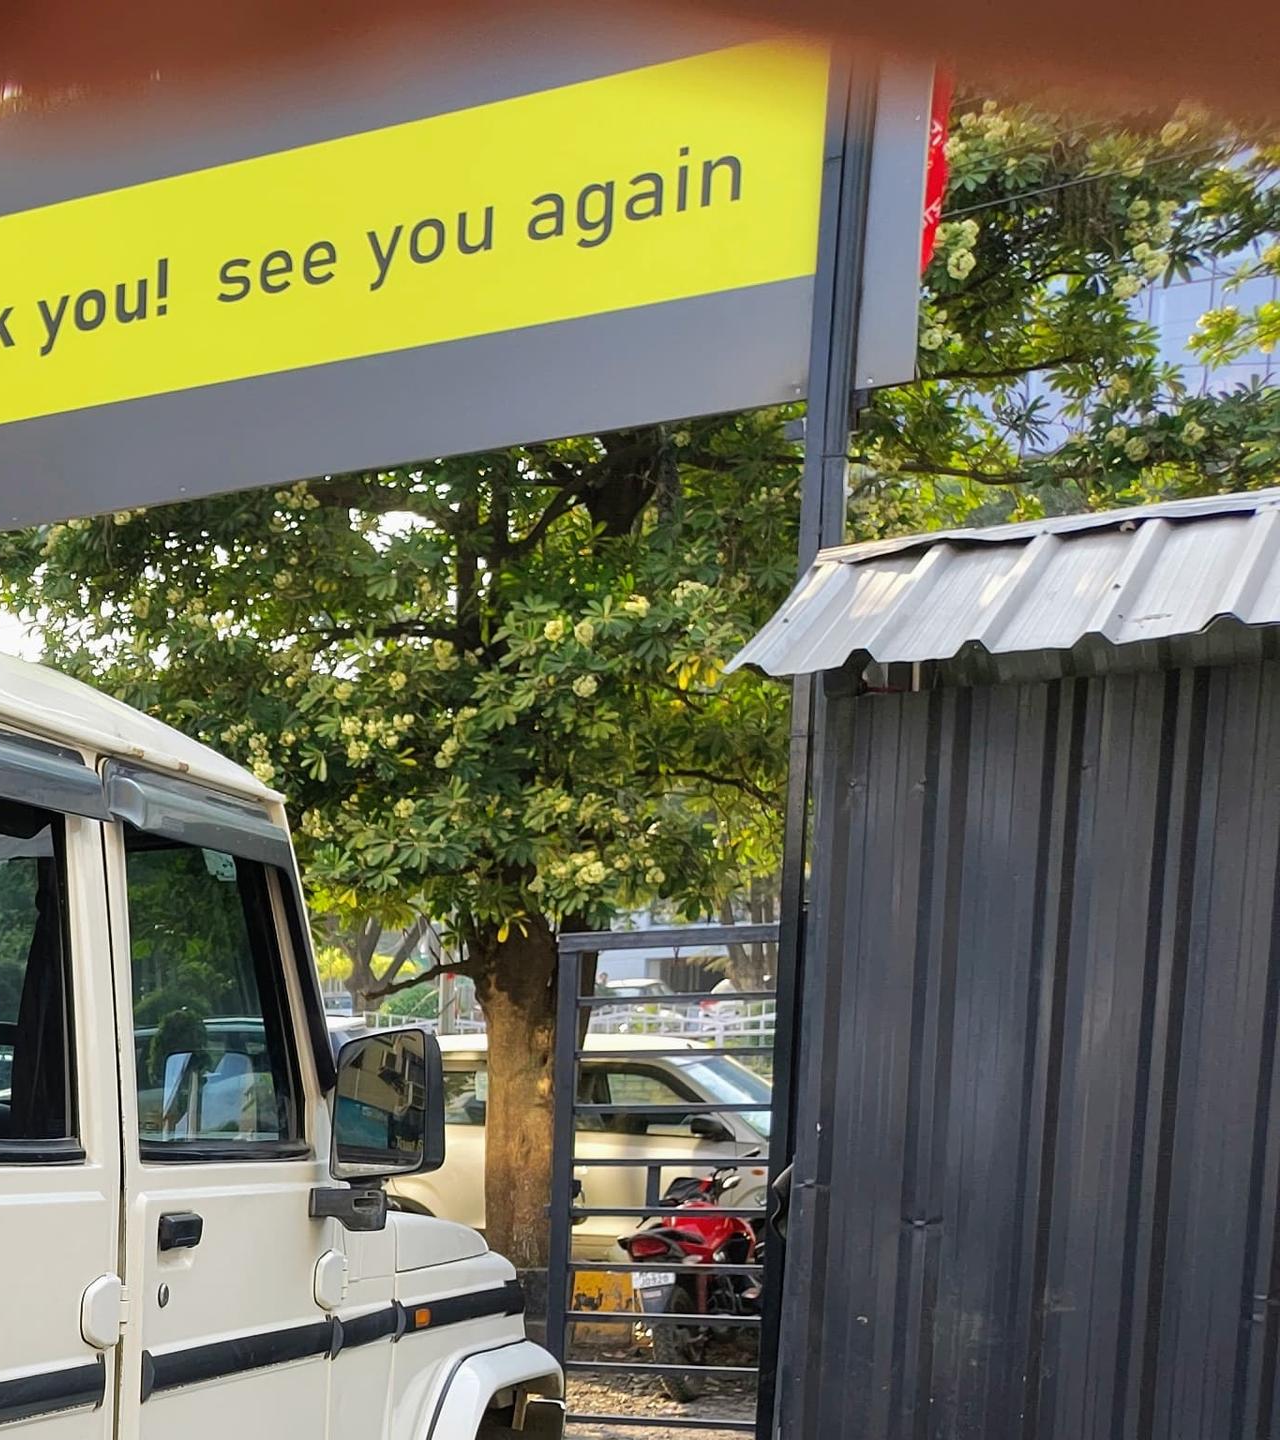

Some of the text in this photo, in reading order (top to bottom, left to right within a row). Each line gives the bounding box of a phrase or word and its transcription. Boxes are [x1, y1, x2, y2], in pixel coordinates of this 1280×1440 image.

[38, 258, 169, 355] you!
[217, 240, 338, 303] see
[365, 203, 496, 290] you
[525, 147, 744, 250] again
